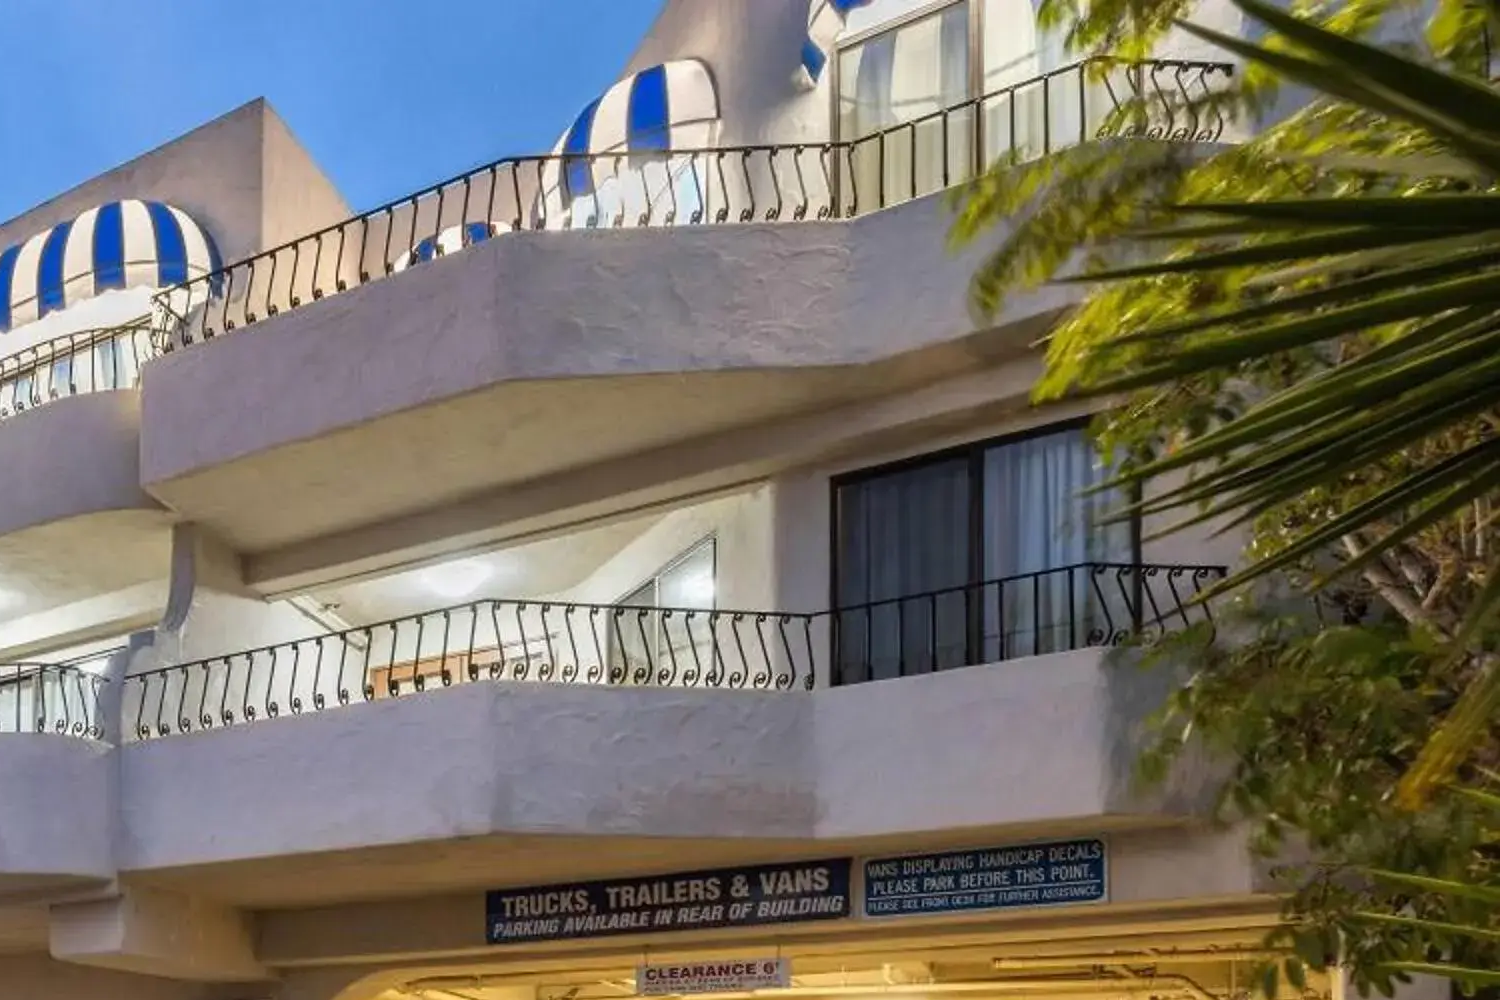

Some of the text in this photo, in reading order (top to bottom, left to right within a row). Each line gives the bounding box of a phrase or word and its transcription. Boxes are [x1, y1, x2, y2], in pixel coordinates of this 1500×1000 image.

[867, 843, 1100, 877] VANS DISPLAYING HANDICAP DECALS
[501, 867, 830, 917] TRUCKS, TRAILERS & VANS
[873, 877, 918, 896] PLEASE
[923, 875, 955, 891] PARK
[961, 871, 1011, 888] BEFORE
[1015, 866, 1045, 884] THIS
[494, 895, 844, 939] PARKING AVAILABLE IN REAR OF BUILDING
[645, 963, 757, 981] CLEARANCE
